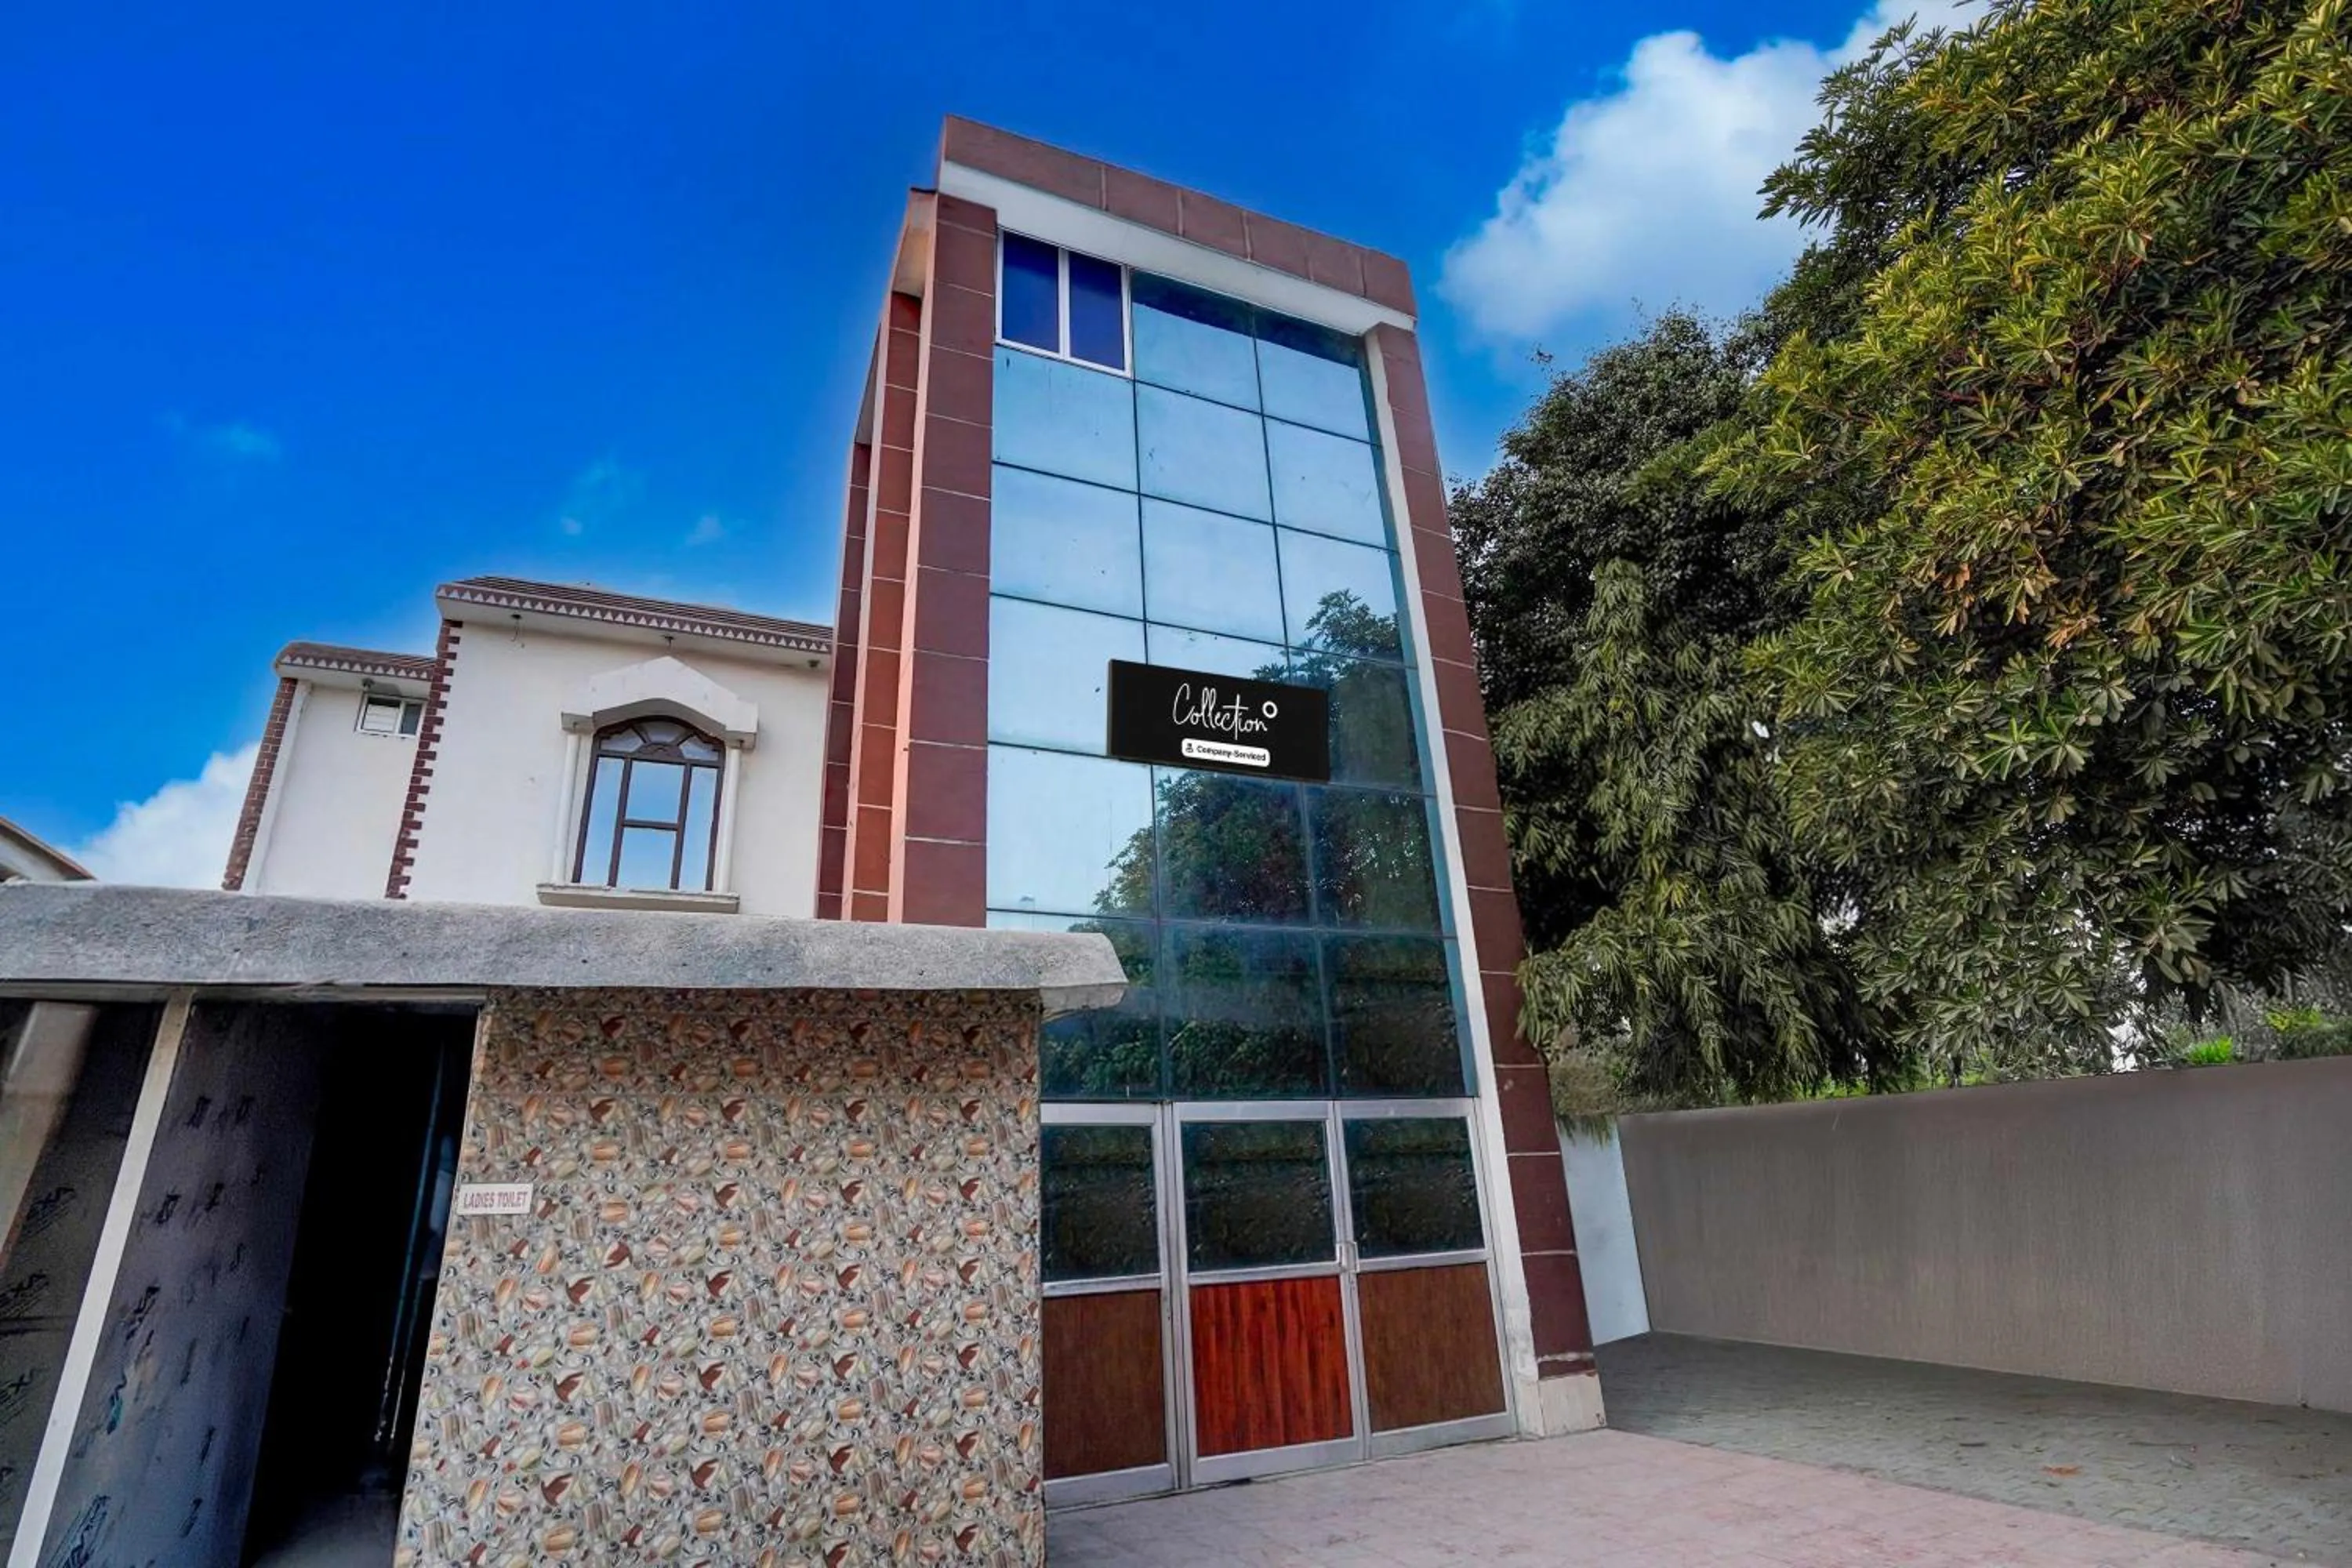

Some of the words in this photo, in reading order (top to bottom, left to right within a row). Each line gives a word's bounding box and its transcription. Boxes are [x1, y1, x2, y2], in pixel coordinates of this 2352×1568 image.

[1173, 683, 1268, 740] Collection
[464, 1192, 495, 1208] LADIES
[497, 1191, 528, 1208] TOILET
